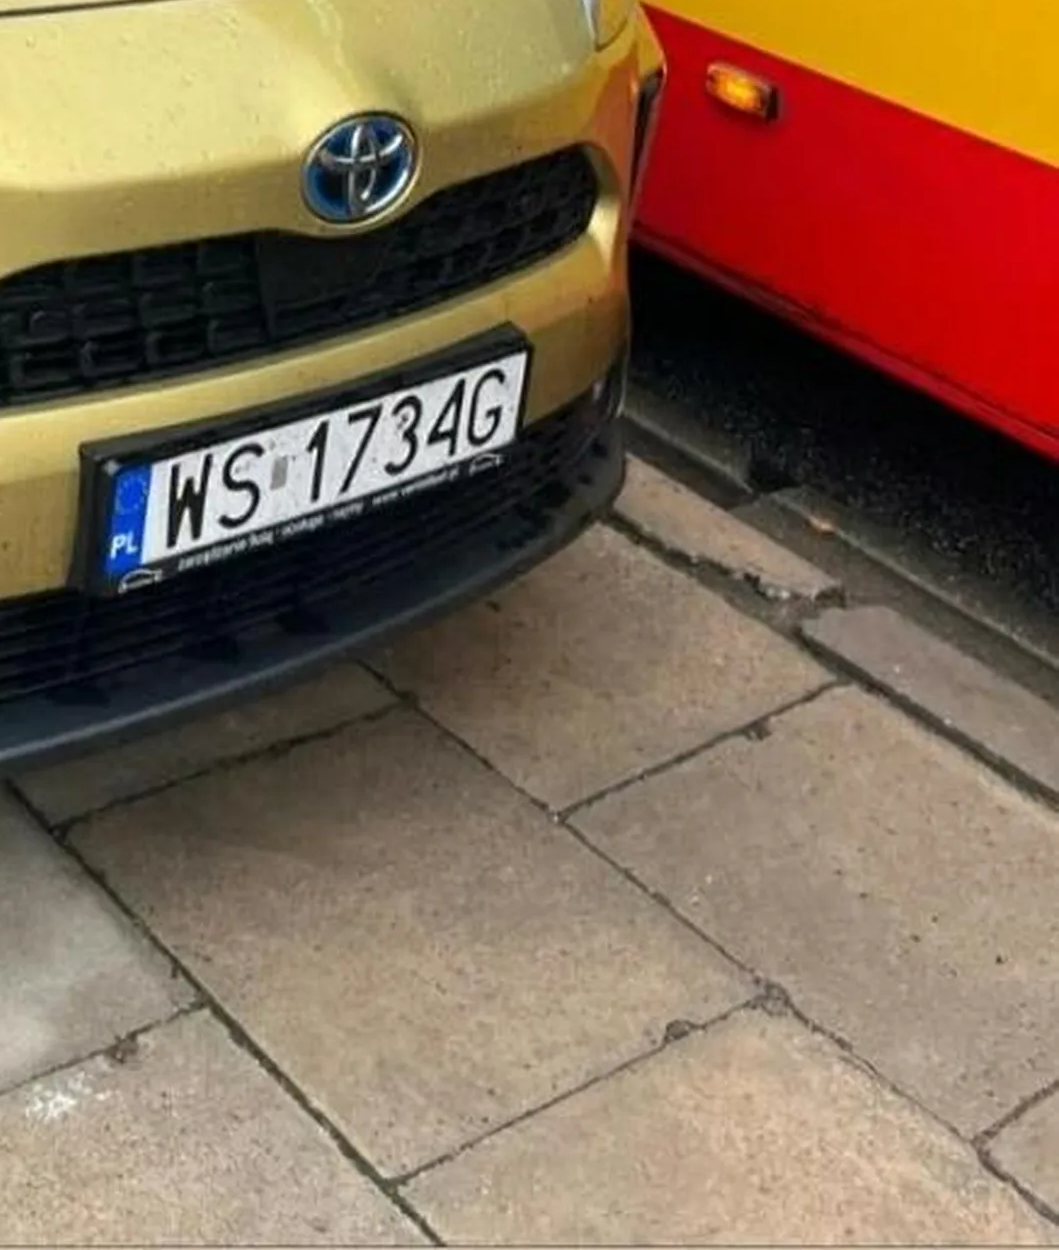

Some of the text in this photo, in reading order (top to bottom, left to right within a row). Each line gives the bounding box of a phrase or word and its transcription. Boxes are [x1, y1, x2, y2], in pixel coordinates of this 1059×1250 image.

[166, 443, 266, 549] WS
[306, 369, 507, 503] 1734G
[110, 531, 138, 561] PL
